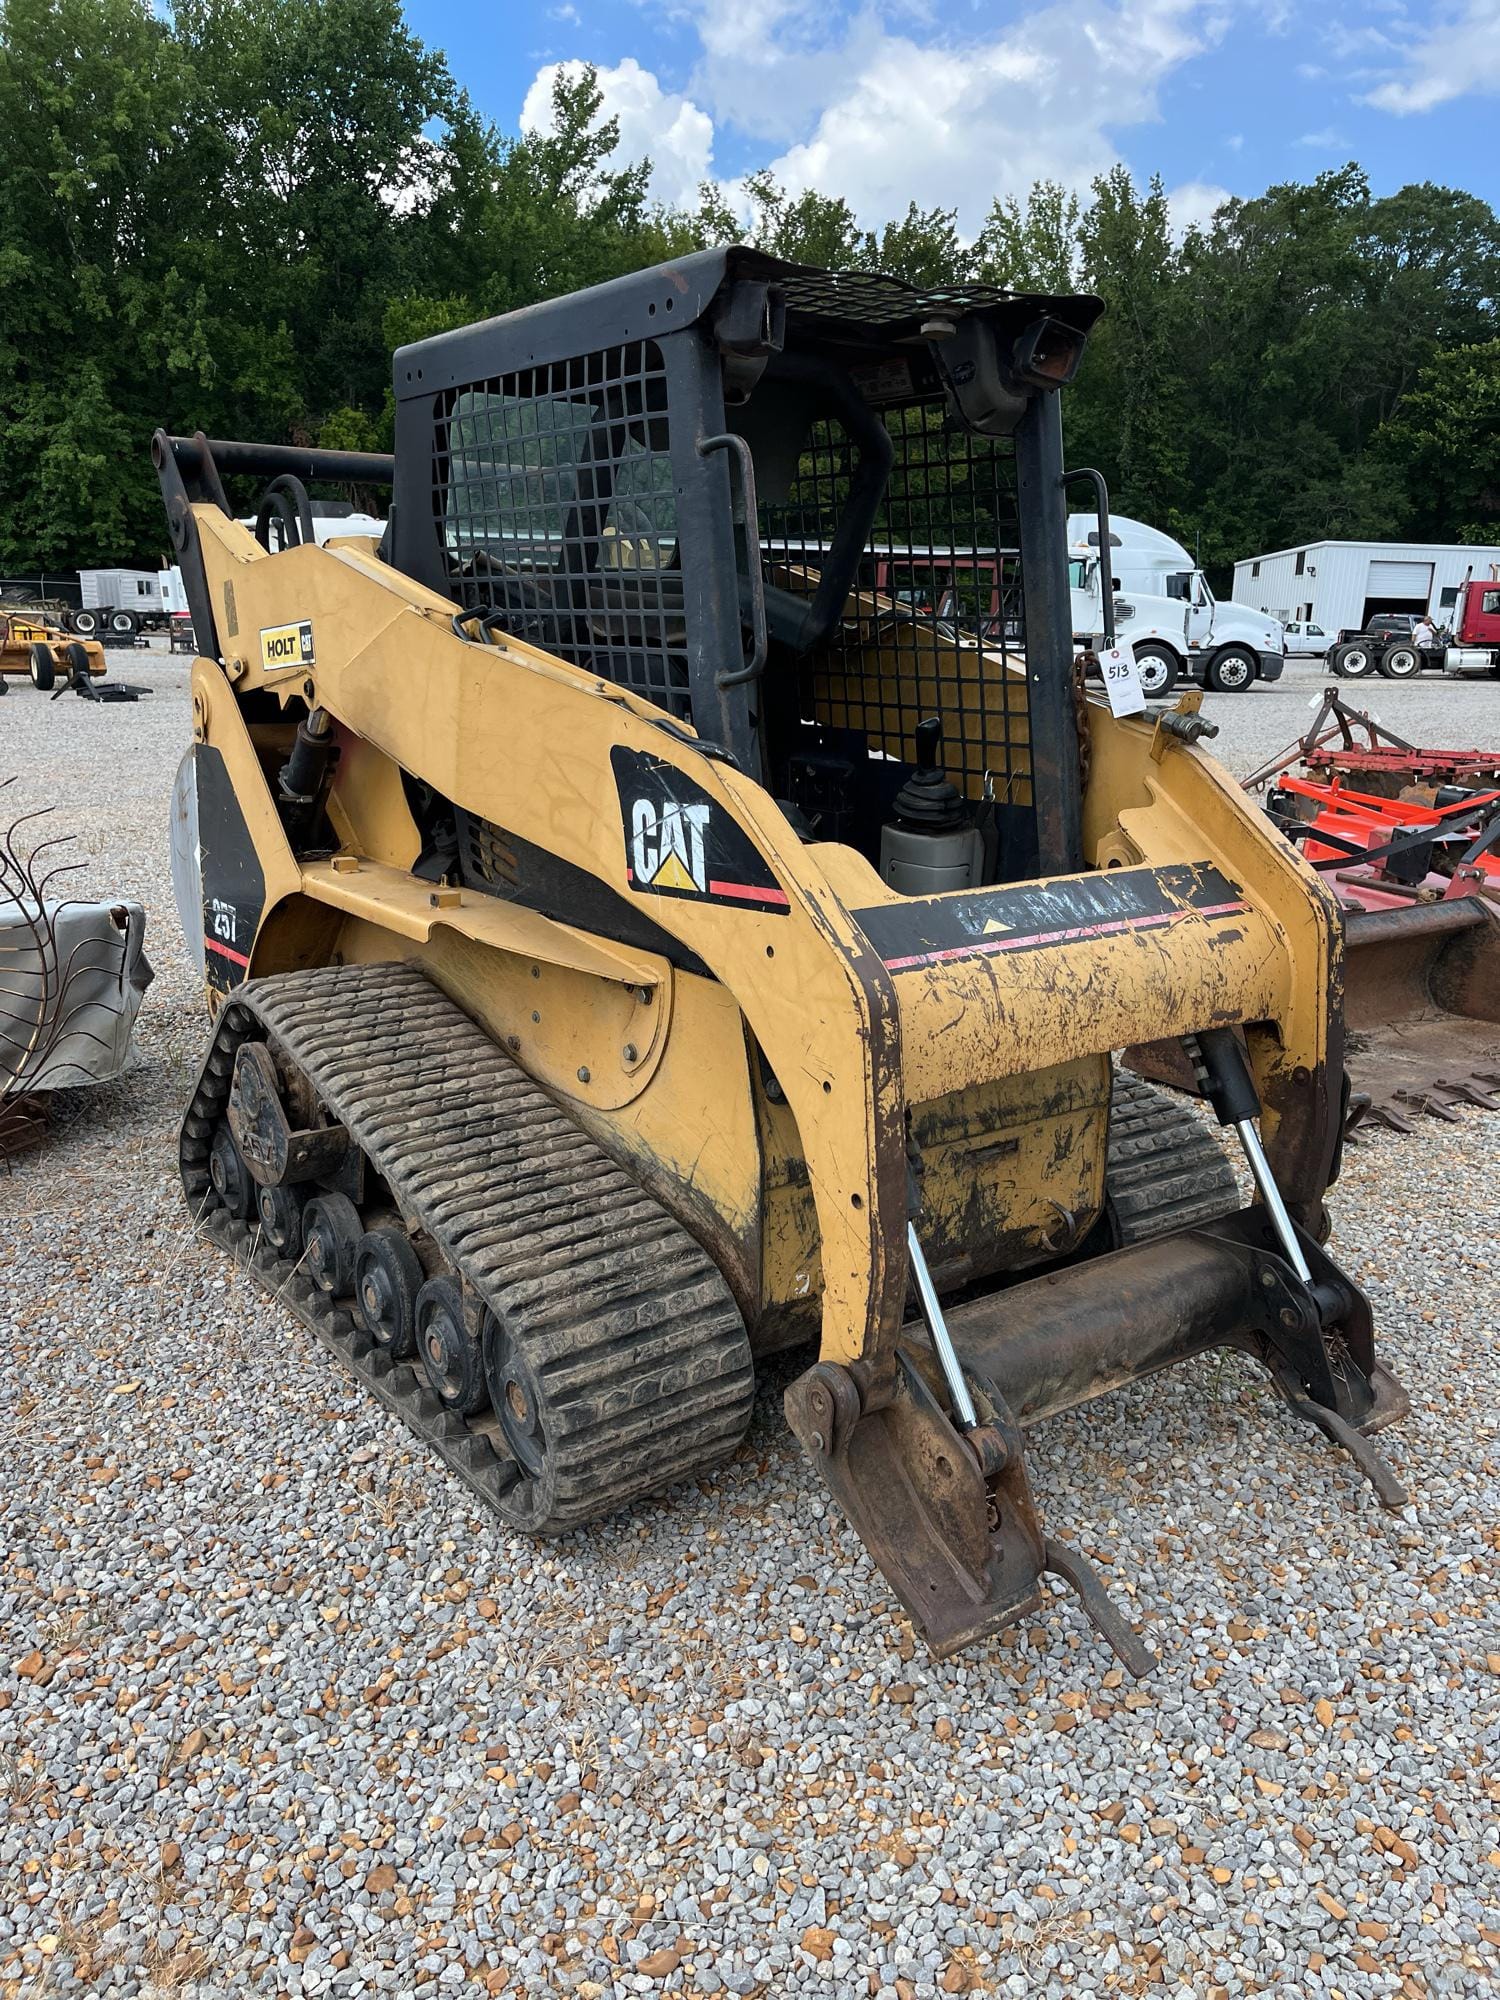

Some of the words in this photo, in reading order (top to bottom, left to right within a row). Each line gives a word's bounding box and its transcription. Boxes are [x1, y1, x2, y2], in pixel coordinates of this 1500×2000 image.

[267, 637, 295, 657] HOLT
[1108, 664, 1130, 680] 513
[632, 798, 710, 893] CAT
[212, 898, 237, 943] 257
